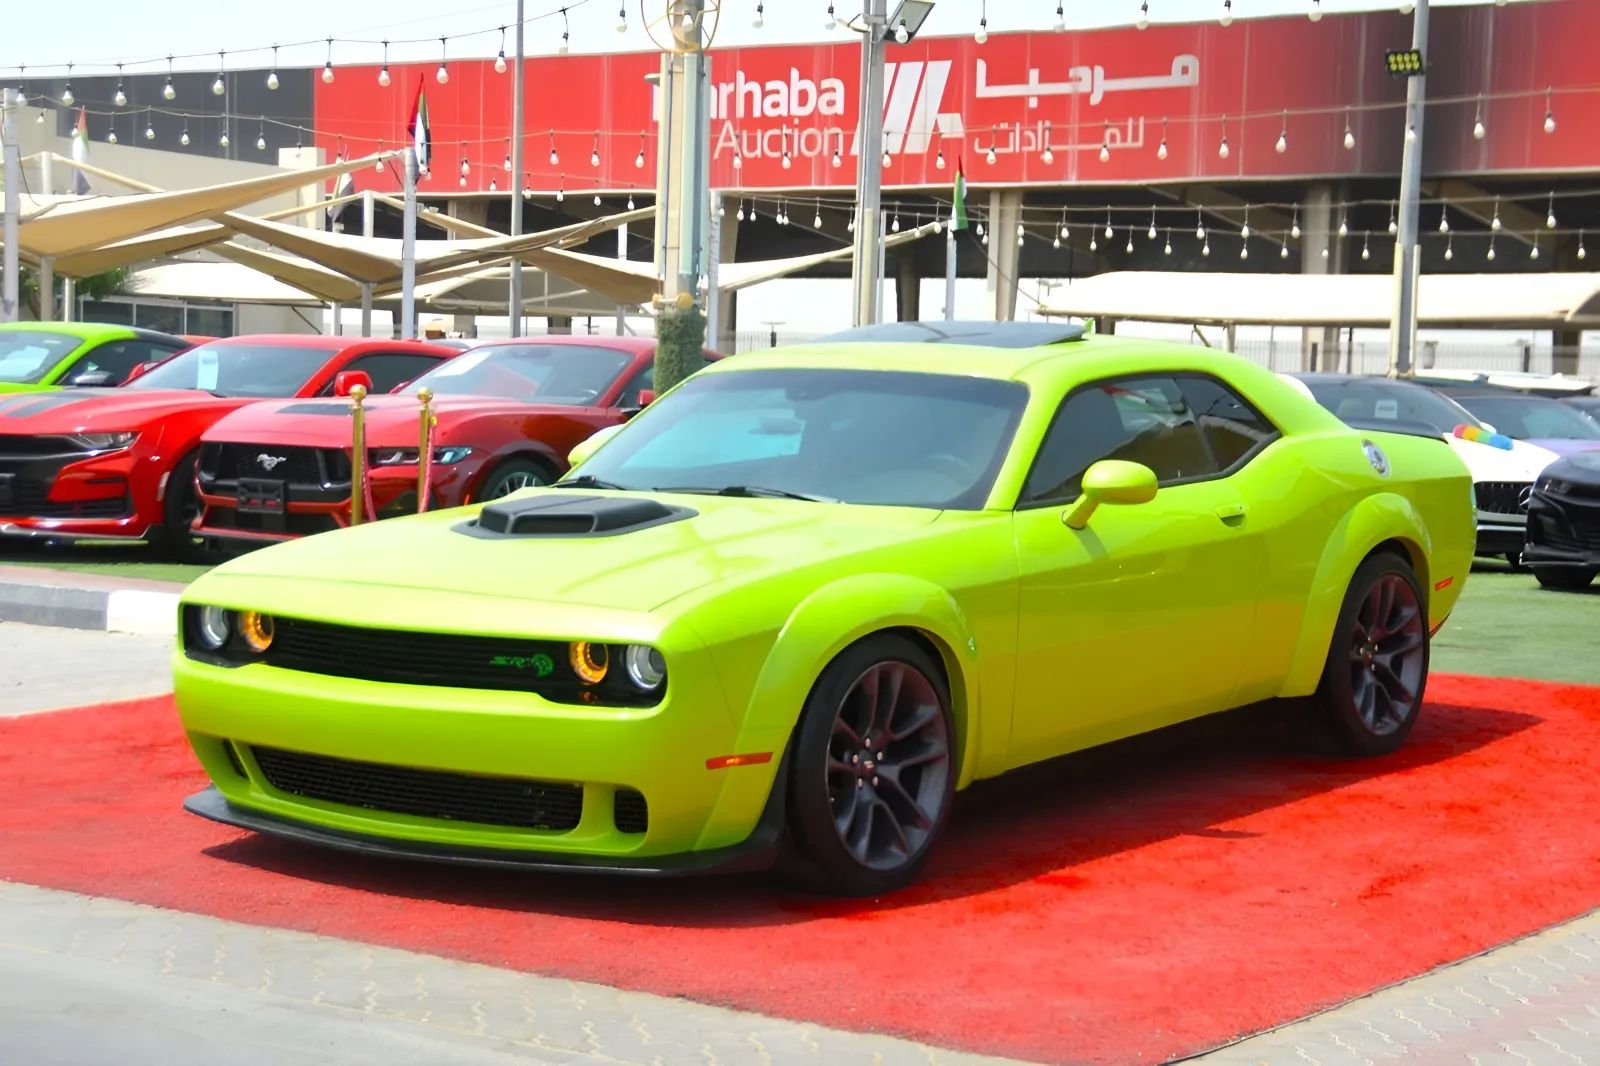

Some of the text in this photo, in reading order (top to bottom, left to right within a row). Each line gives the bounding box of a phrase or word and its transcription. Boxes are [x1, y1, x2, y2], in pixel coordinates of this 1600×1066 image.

[653, 67, 845, 122] rhaba
[976, 54, 1200, 108] مرحبا
[713, 118, 844, 159] Auction
[974, 116, 1144, 154] للمزادات
